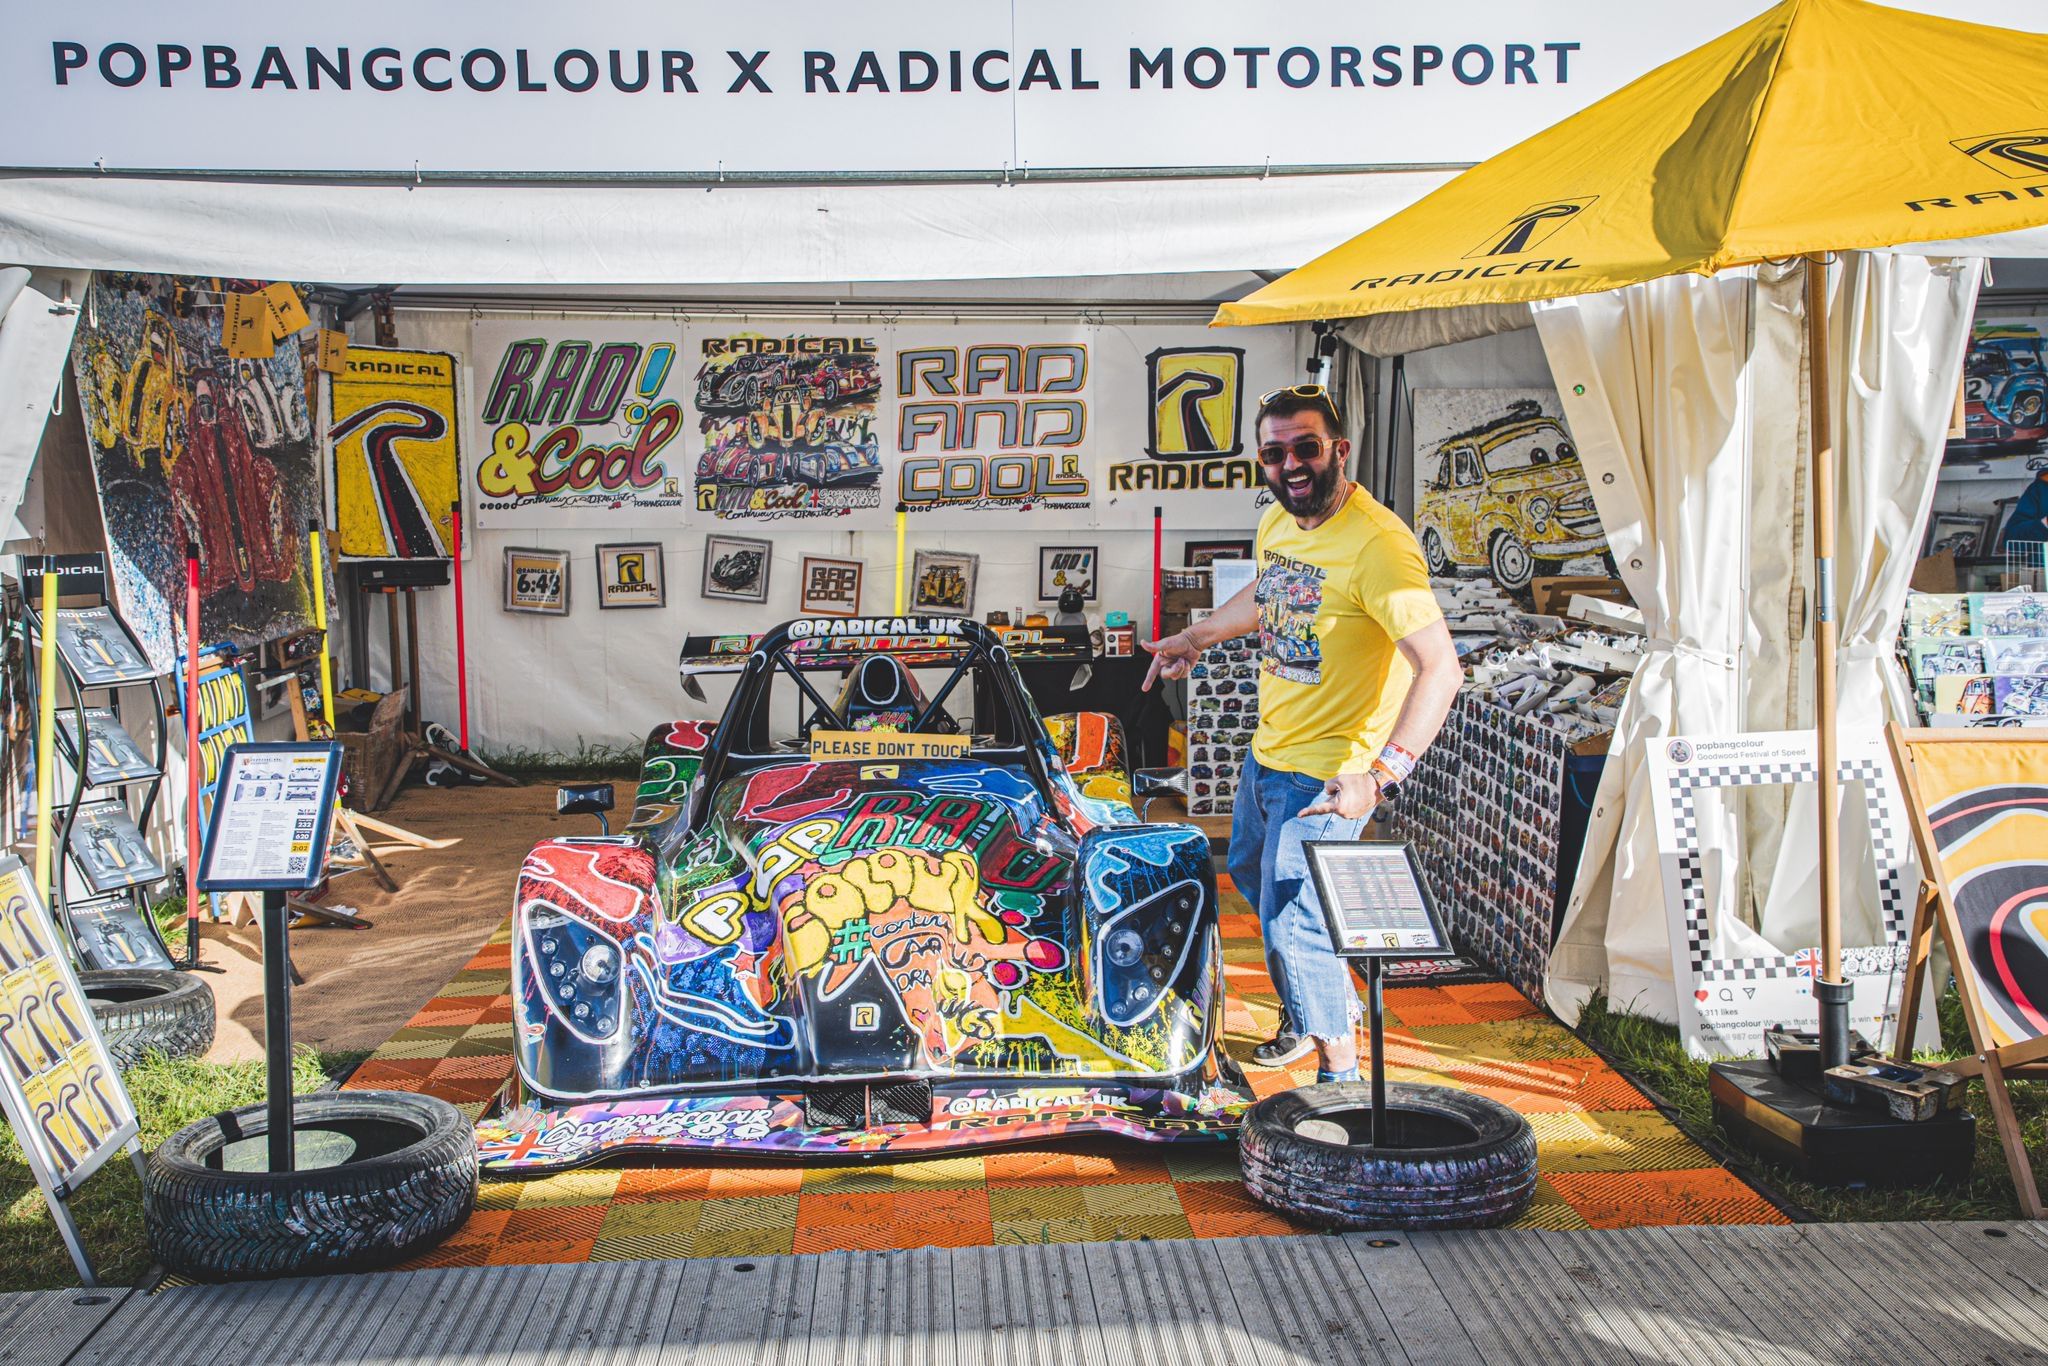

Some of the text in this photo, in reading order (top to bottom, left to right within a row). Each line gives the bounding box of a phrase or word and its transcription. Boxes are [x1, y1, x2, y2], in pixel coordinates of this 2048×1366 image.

[52, 42, 1581, 94] POPBANGCOLOUR X RADICAL MOTORSPORT
[1351, 257, 1581, 291] RADICAL
[702, 337, 877, 353] RADICAL
[346, 361, 445, 377] RADICAL
[897, 344, 1088, 397] RAD
[897, 399, 1087, 452] AND
[533, 399, 684, 495] Cool
[897, 453, 1089, 505] COOL
[26, 566, 104, 576] RDICAL
[1263, 550, 1326, 579] RADICAL
[812, 567, 856, 580] RAD
[608, 583, 656, 594] RADICAL
[811, 579, 856, 591] AND
[806, 590, 854, 601] COOL
[57, 610, 108, 618] ADICAL
[788, 618, 964, 639] @RADICAL.UK
[813, 740, 970, 758] PLEASE DONT TOUCH
[1696, 740, 1764, 751] popbangcolour
[1697, 752, 1738, 761] Goodwood
[1740, 750, 1769, 758] Festival
[1781, 748, 1806, 757] Speed
[71, 902, 130, 915] RADICAL
[1720, 1008, 1738, 1016] likes
[1700, 1020, 1761, 1031] popbangcolour
[1858, 1015, 1872, 1023] win
[1702, 1034, 1720, 1042] View
[949, 1093, 1128, 1116] @RADICAL.UK
